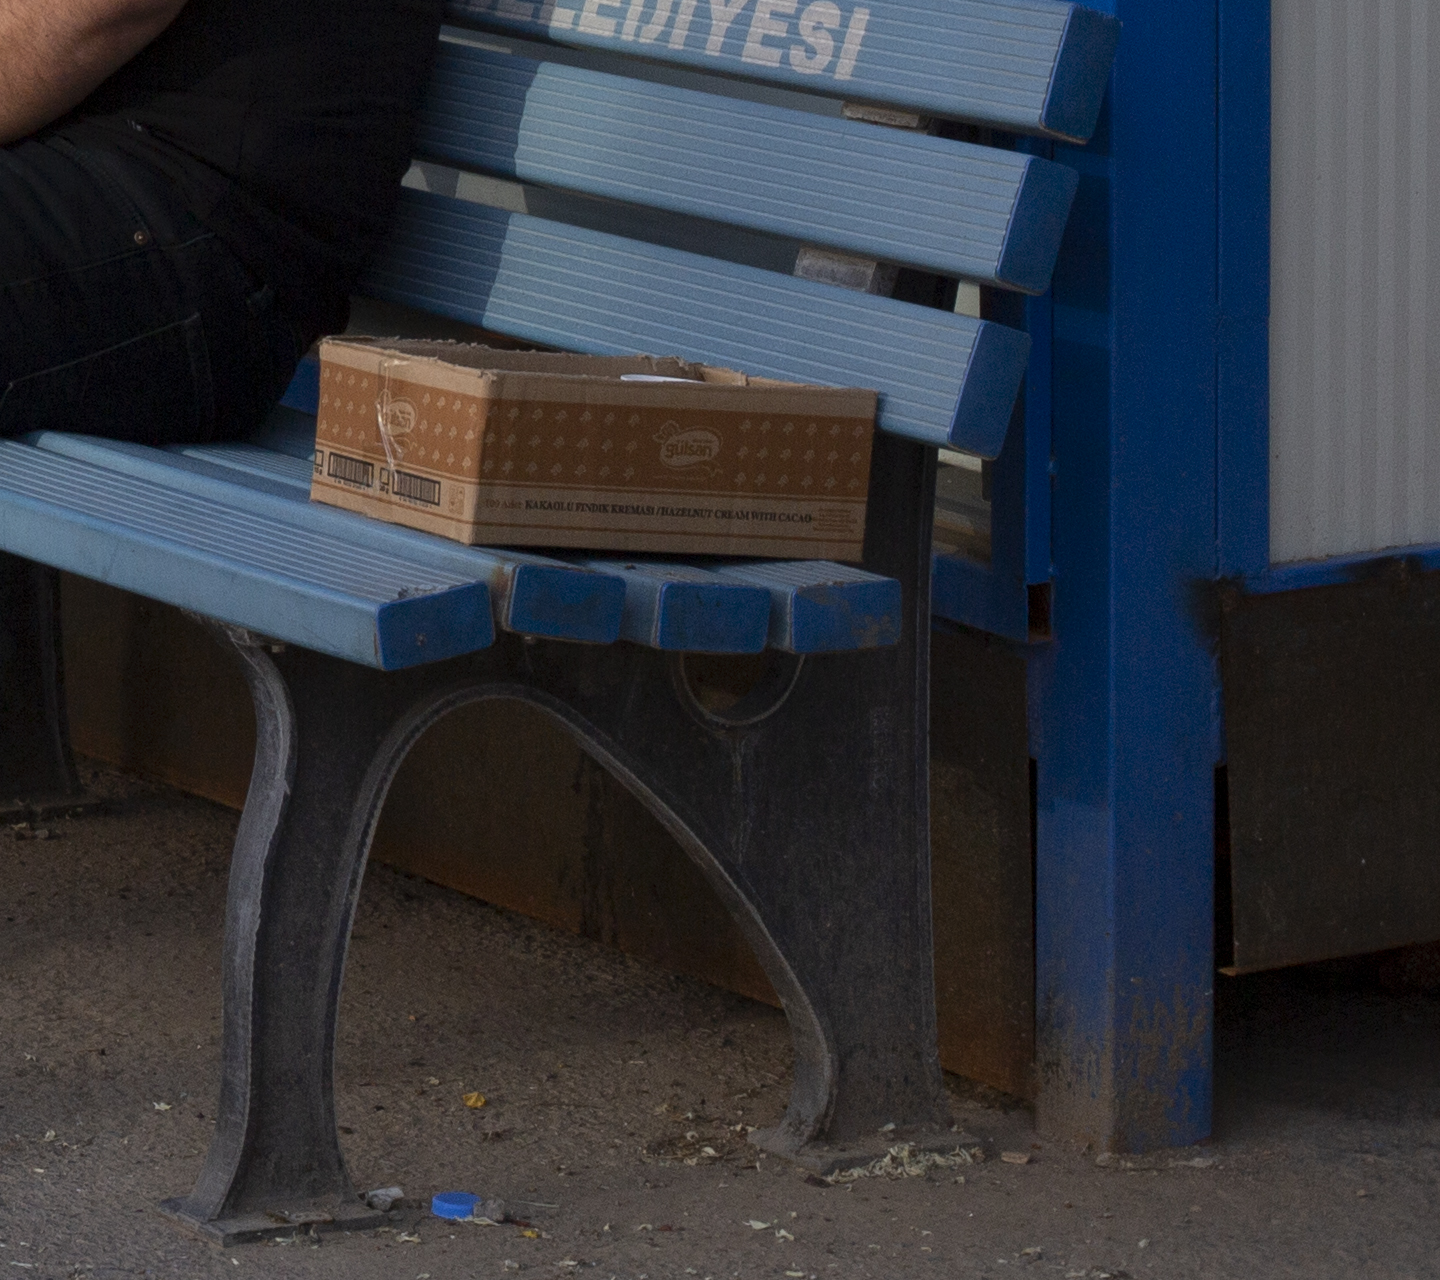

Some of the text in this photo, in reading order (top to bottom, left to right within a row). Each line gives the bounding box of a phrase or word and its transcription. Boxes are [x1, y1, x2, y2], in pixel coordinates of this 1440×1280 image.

[525, 499, 574, 512] KAKAOLU
[575, 502, 609, 514] FINDIK
[610, 504, 655, 516] KREMASI
[661, 506, 713, 519] HAZELNUT
[714, 508, 750, 521] CREAM
[751, 511, 776, 522] WITH
[778, 512, 812, 524] CACAO
